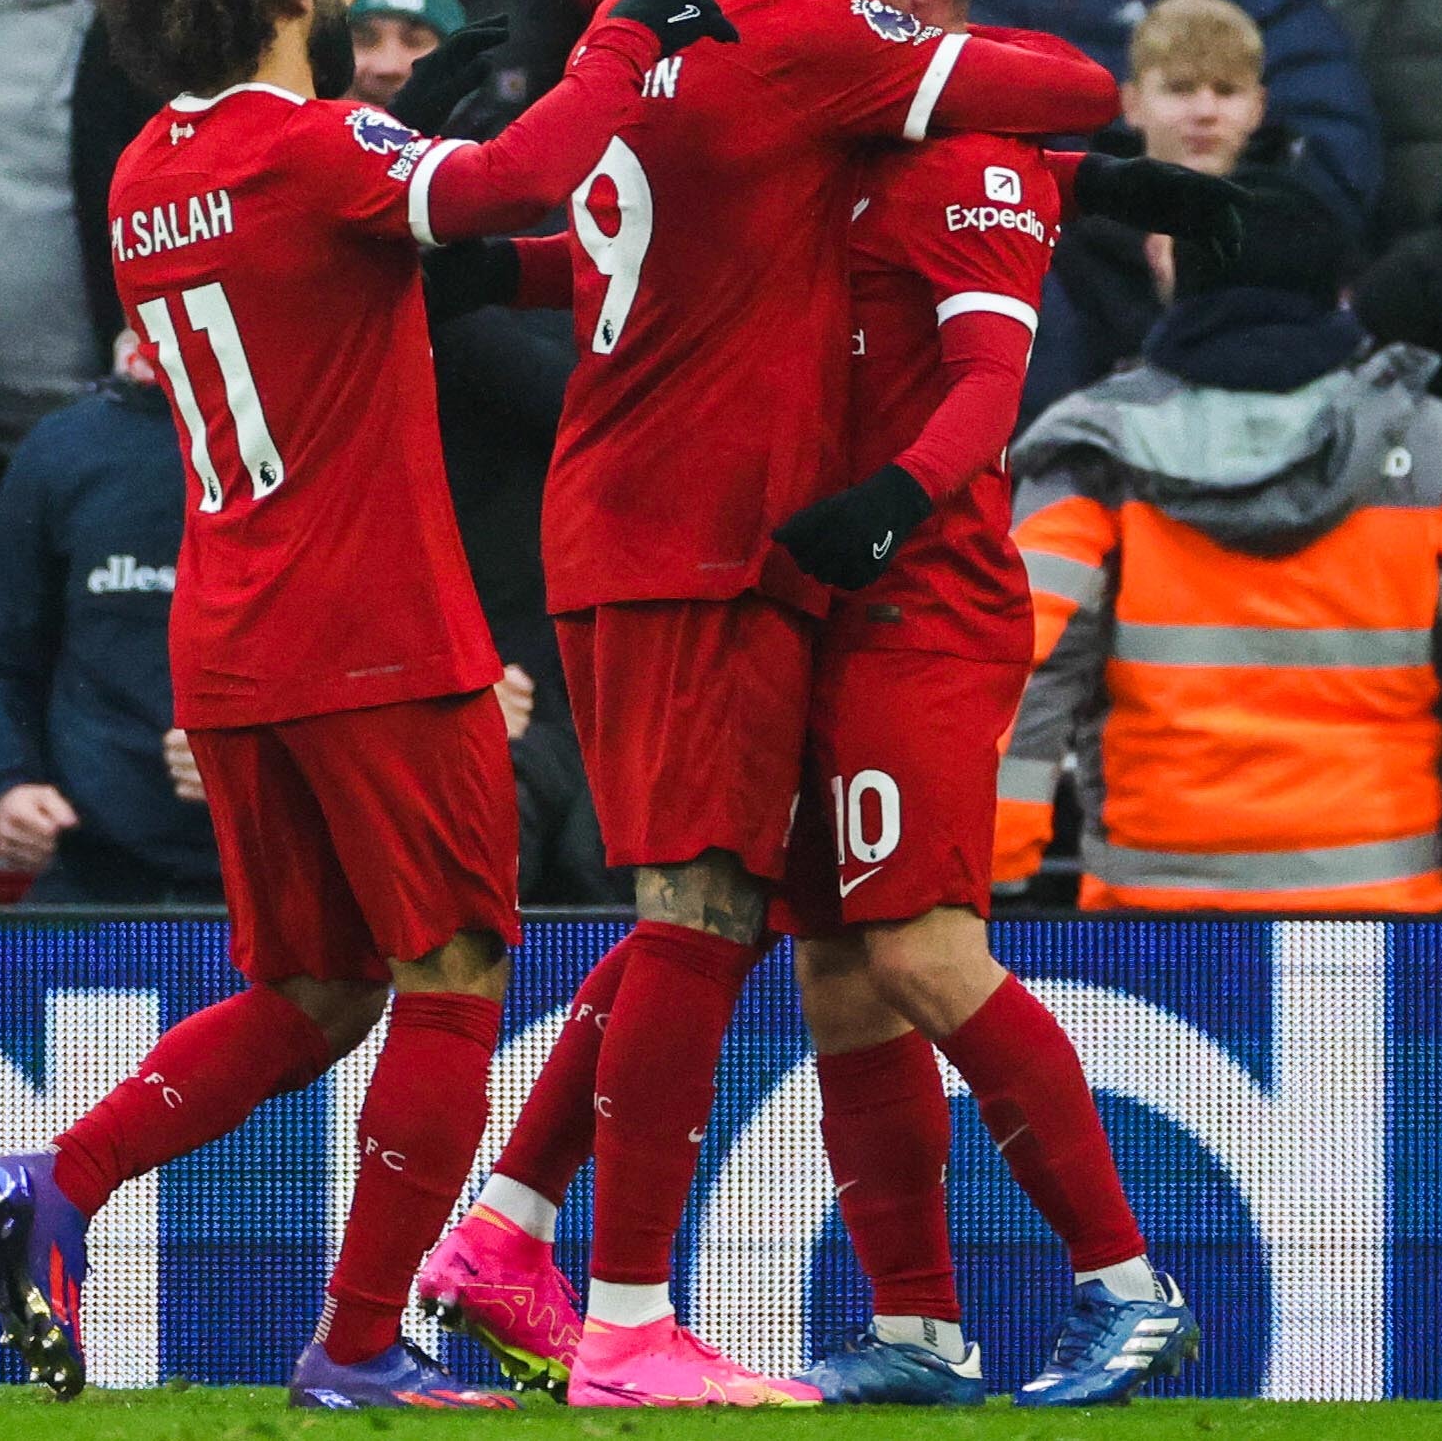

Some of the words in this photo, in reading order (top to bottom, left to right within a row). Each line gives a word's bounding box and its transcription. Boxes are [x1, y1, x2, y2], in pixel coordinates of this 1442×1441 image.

[111, 189, 234, 263] M.SALAH
[571, 135, 653, 354] 9
[945, 204, 1045, 244] Expedia
[137, 281, 284, 514] 11
[830, 769, 901, 866] 10
